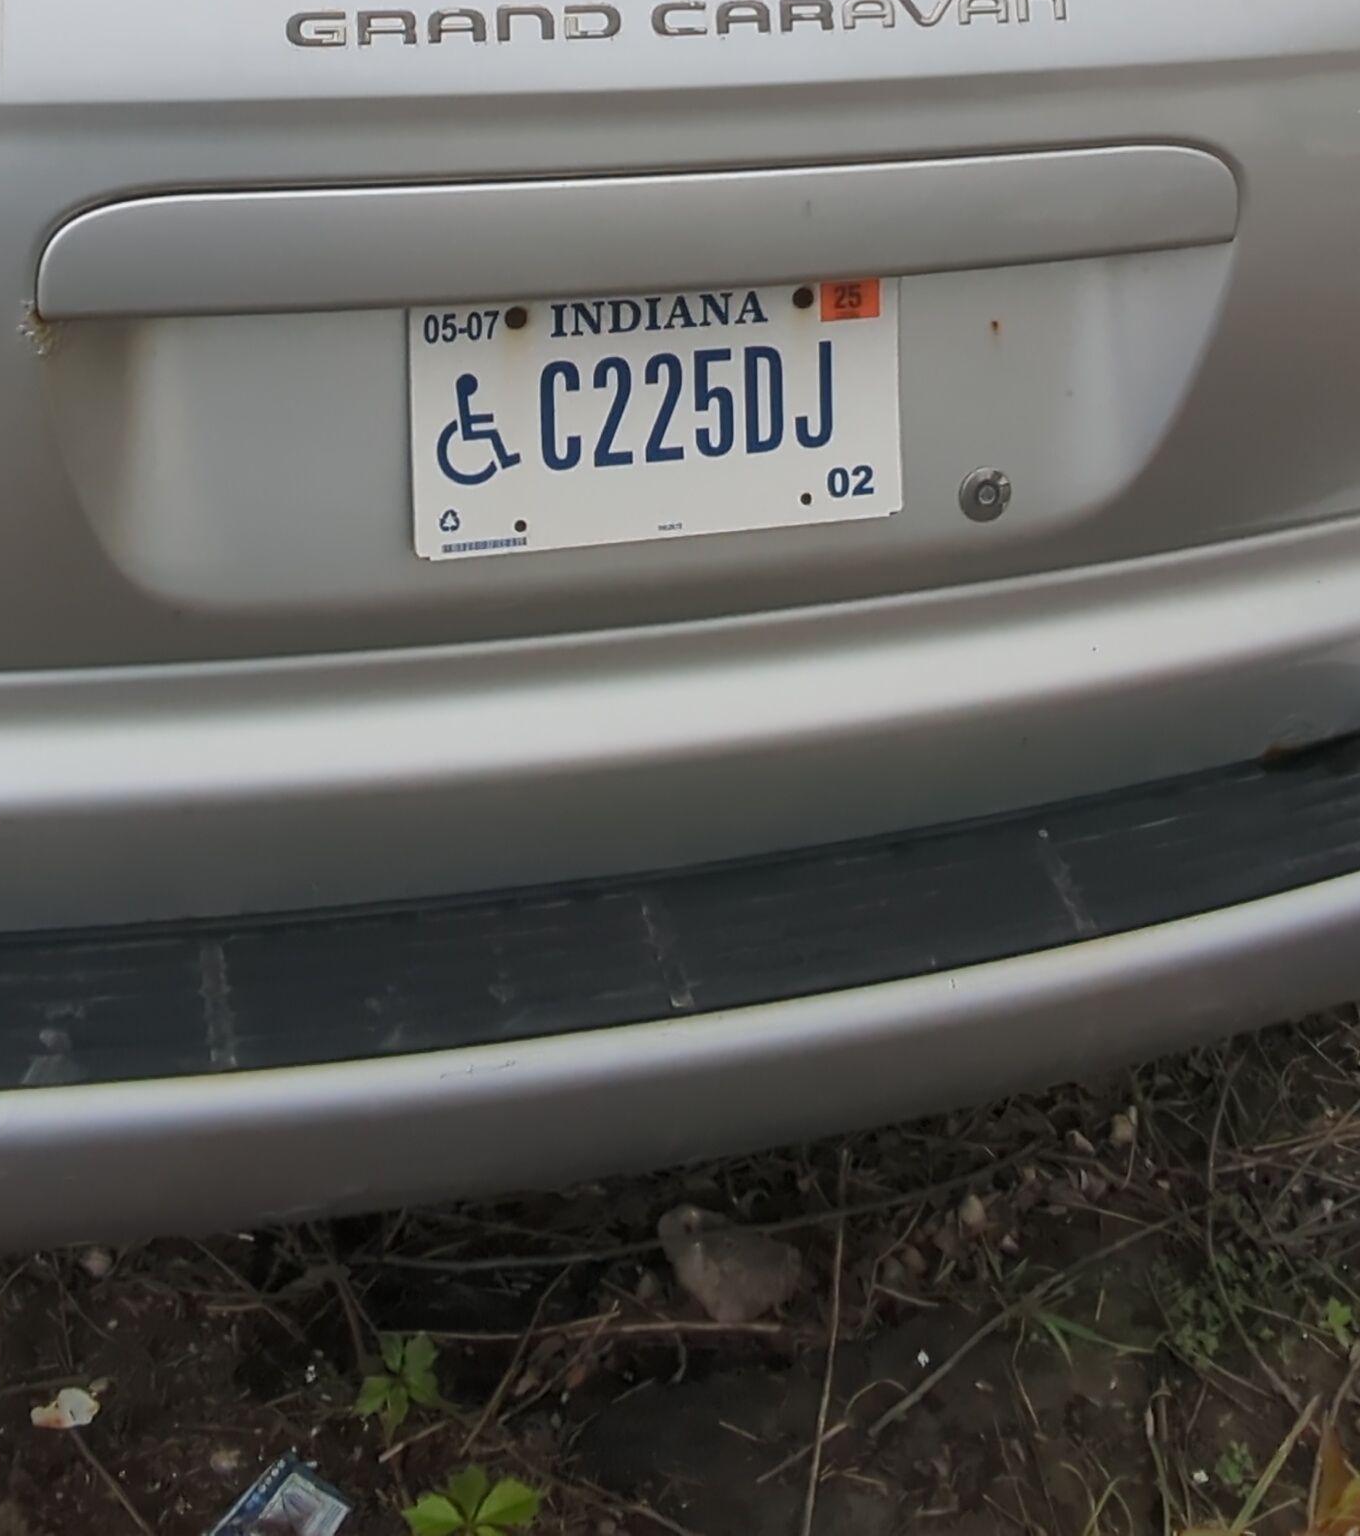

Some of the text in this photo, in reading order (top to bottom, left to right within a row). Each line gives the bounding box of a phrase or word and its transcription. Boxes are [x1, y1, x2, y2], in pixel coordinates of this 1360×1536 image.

[285, 1, 622, 48] GRAND
[423, 291, 769, 344] 05-07 INDIANA
[833, 284, 863, 309] 25
[539, 339, 833, 471] C225DJ
[826, 465, 875, 499] 02
